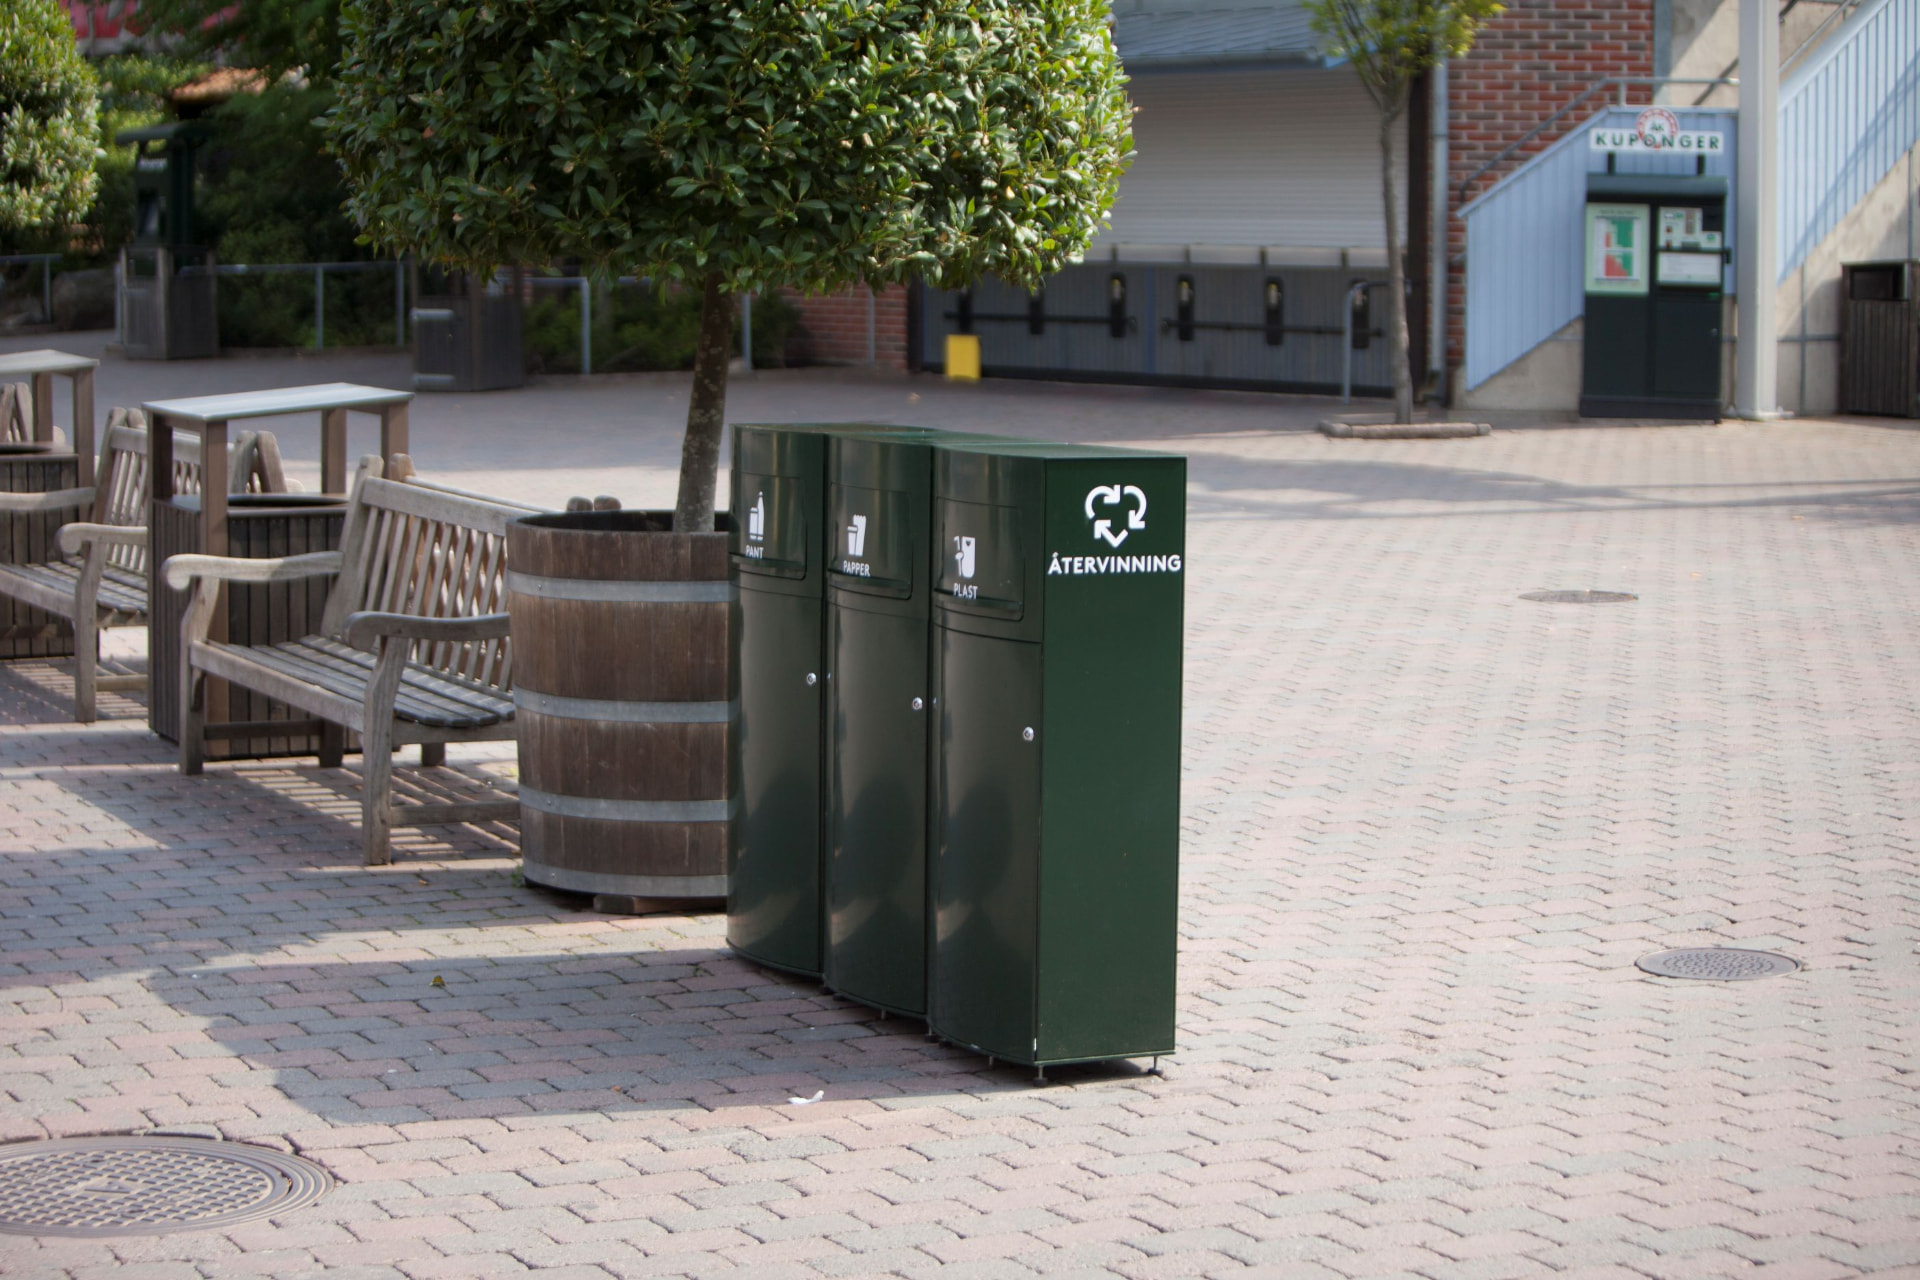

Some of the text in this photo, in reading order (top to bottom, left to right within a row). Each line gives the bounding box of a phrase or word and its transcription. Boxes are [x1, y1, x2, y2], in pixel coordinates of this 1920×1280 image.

[1596, 132, 1719, 149] KUPONGER
[745, 544, 764, 559] PANT
[843, 560, 871, 577] PAPPER
[1047, 551, 1182, 575] ÅTERVINNING
[953, 582, 979, 599] PLAST
